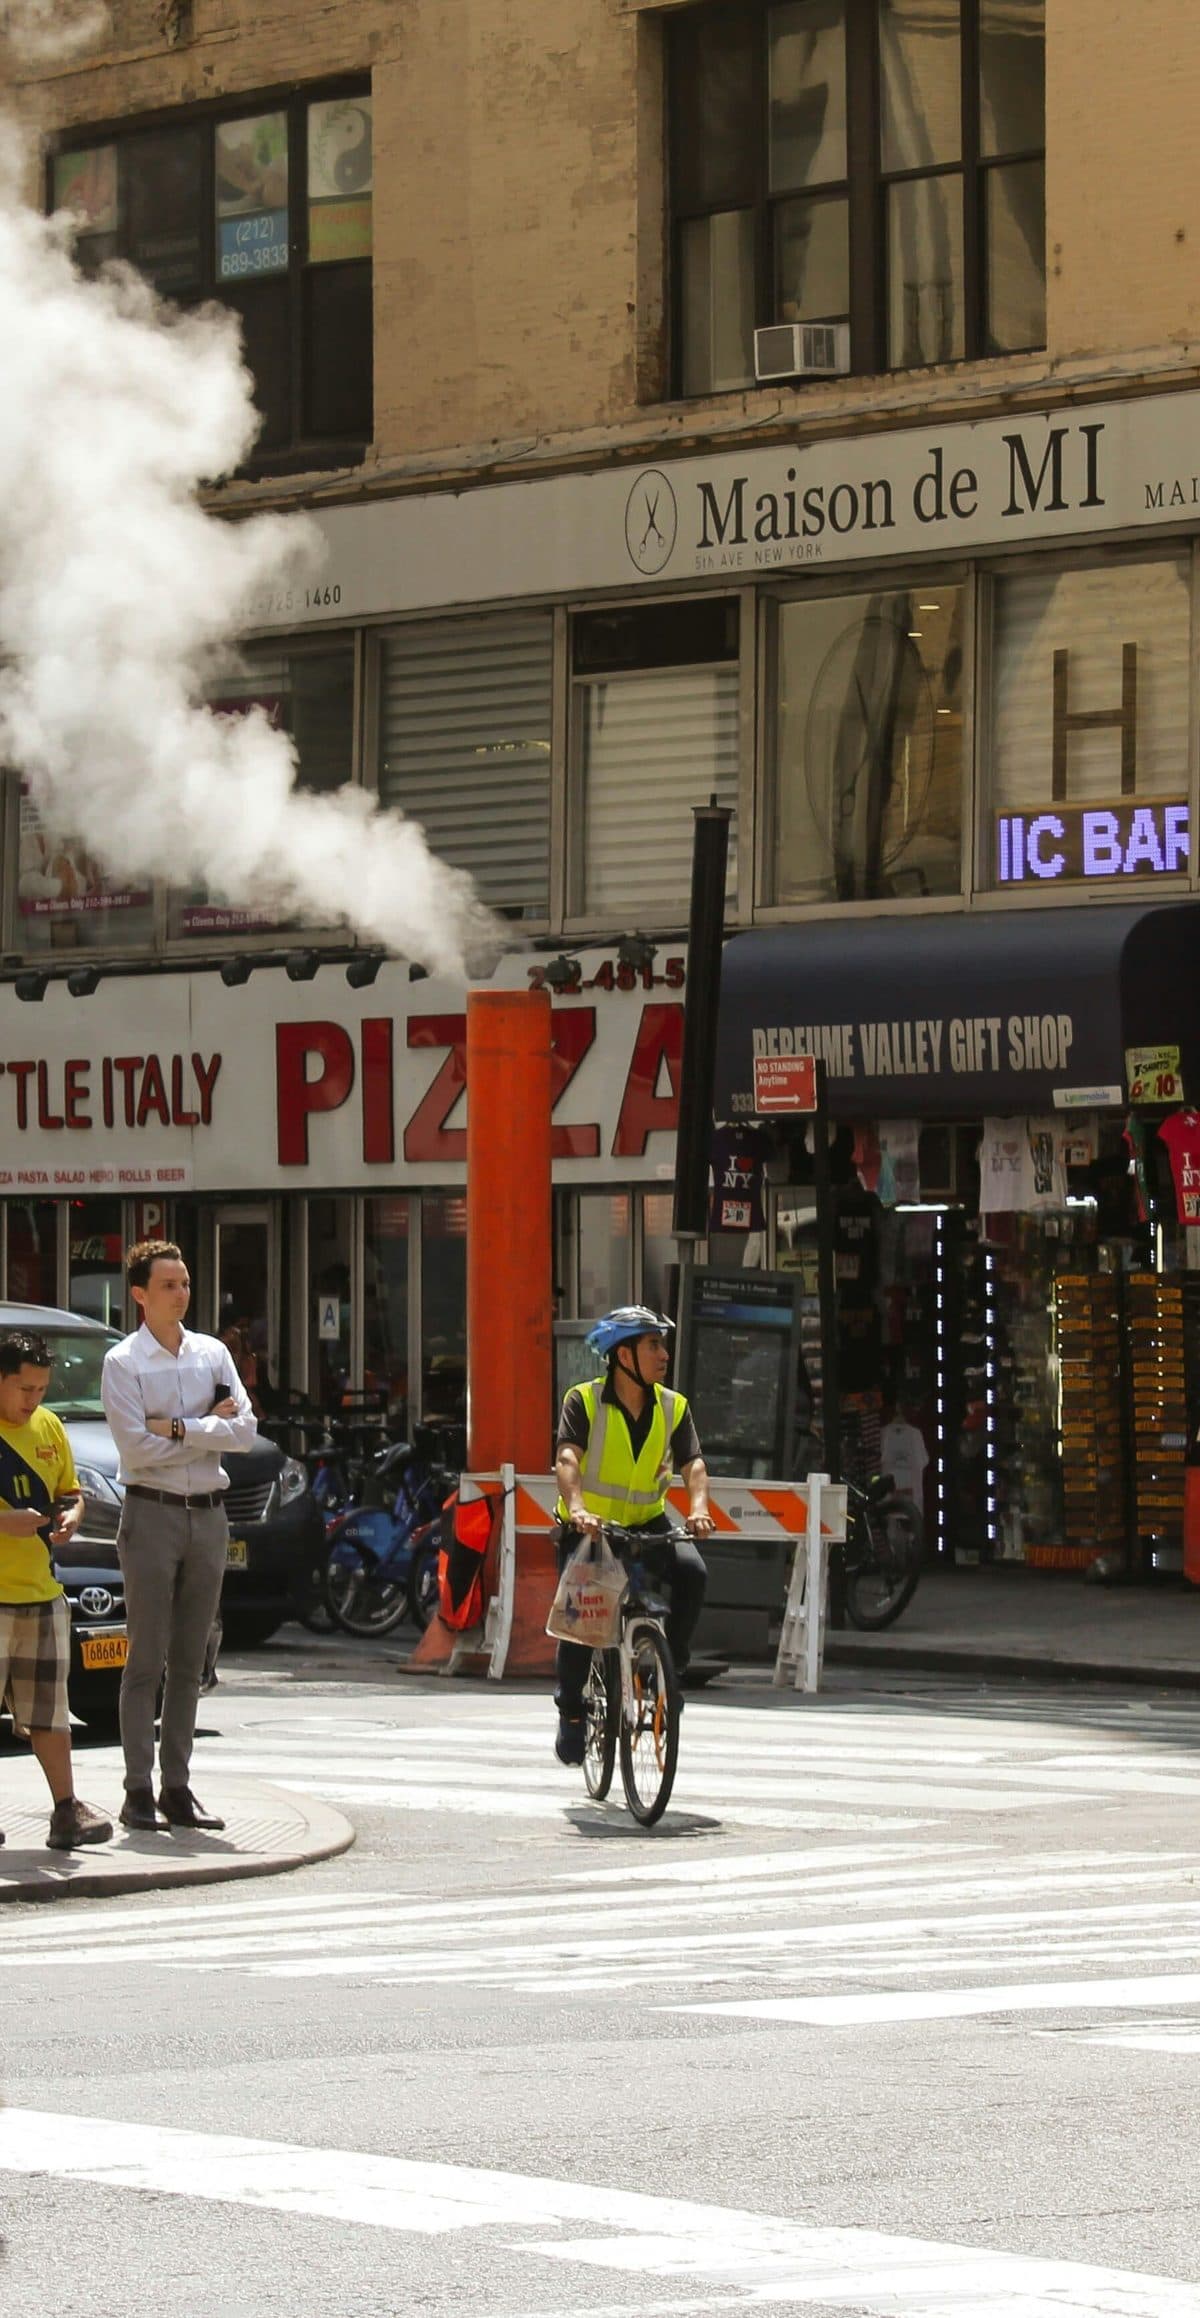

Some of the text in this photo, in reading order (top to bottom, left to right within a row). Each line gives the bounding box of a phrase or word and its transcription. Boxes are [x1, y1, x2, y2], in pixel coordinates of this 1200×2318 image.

[236, 216, 274, 242] (212)
[220, 244, 289, 275] 689-3833
[696, 423, 1106, 549] Maison de MI
[1144, 477, 1199, 510] MAI
[696, 543, 823, 570] 5th AVE NEW YORK
[1052, 641, 1137, 801] H
[1000, 815, 1065, 880] IC
[527, 958, 686, 994] 22-481-5
[860, 1020, 943, 1076] VALLEY
[950, 1017, 1001, 1073] GIFT
[1008, 1014, 1073, 1071] SHOP
[757, 1061, 804, 1073] NO STANDING
[758, 1075, 788, 1088] Anytime
[0, 1053, 222, 1130] TLE ITALY
[276, 1003, 685, 1167] PIZZA
[17, 1170, 49, 1184] PASTA
[54, 1170, 85, 1184] SALAD
[119, 1169, 151, 1182] ROLLS
[157, 1168, 185, 1181] BEER
[722, 1172, 752, 1188] NY
[142, 1202, 161, 1236] P
[323, 1303, 336, 1328] A
